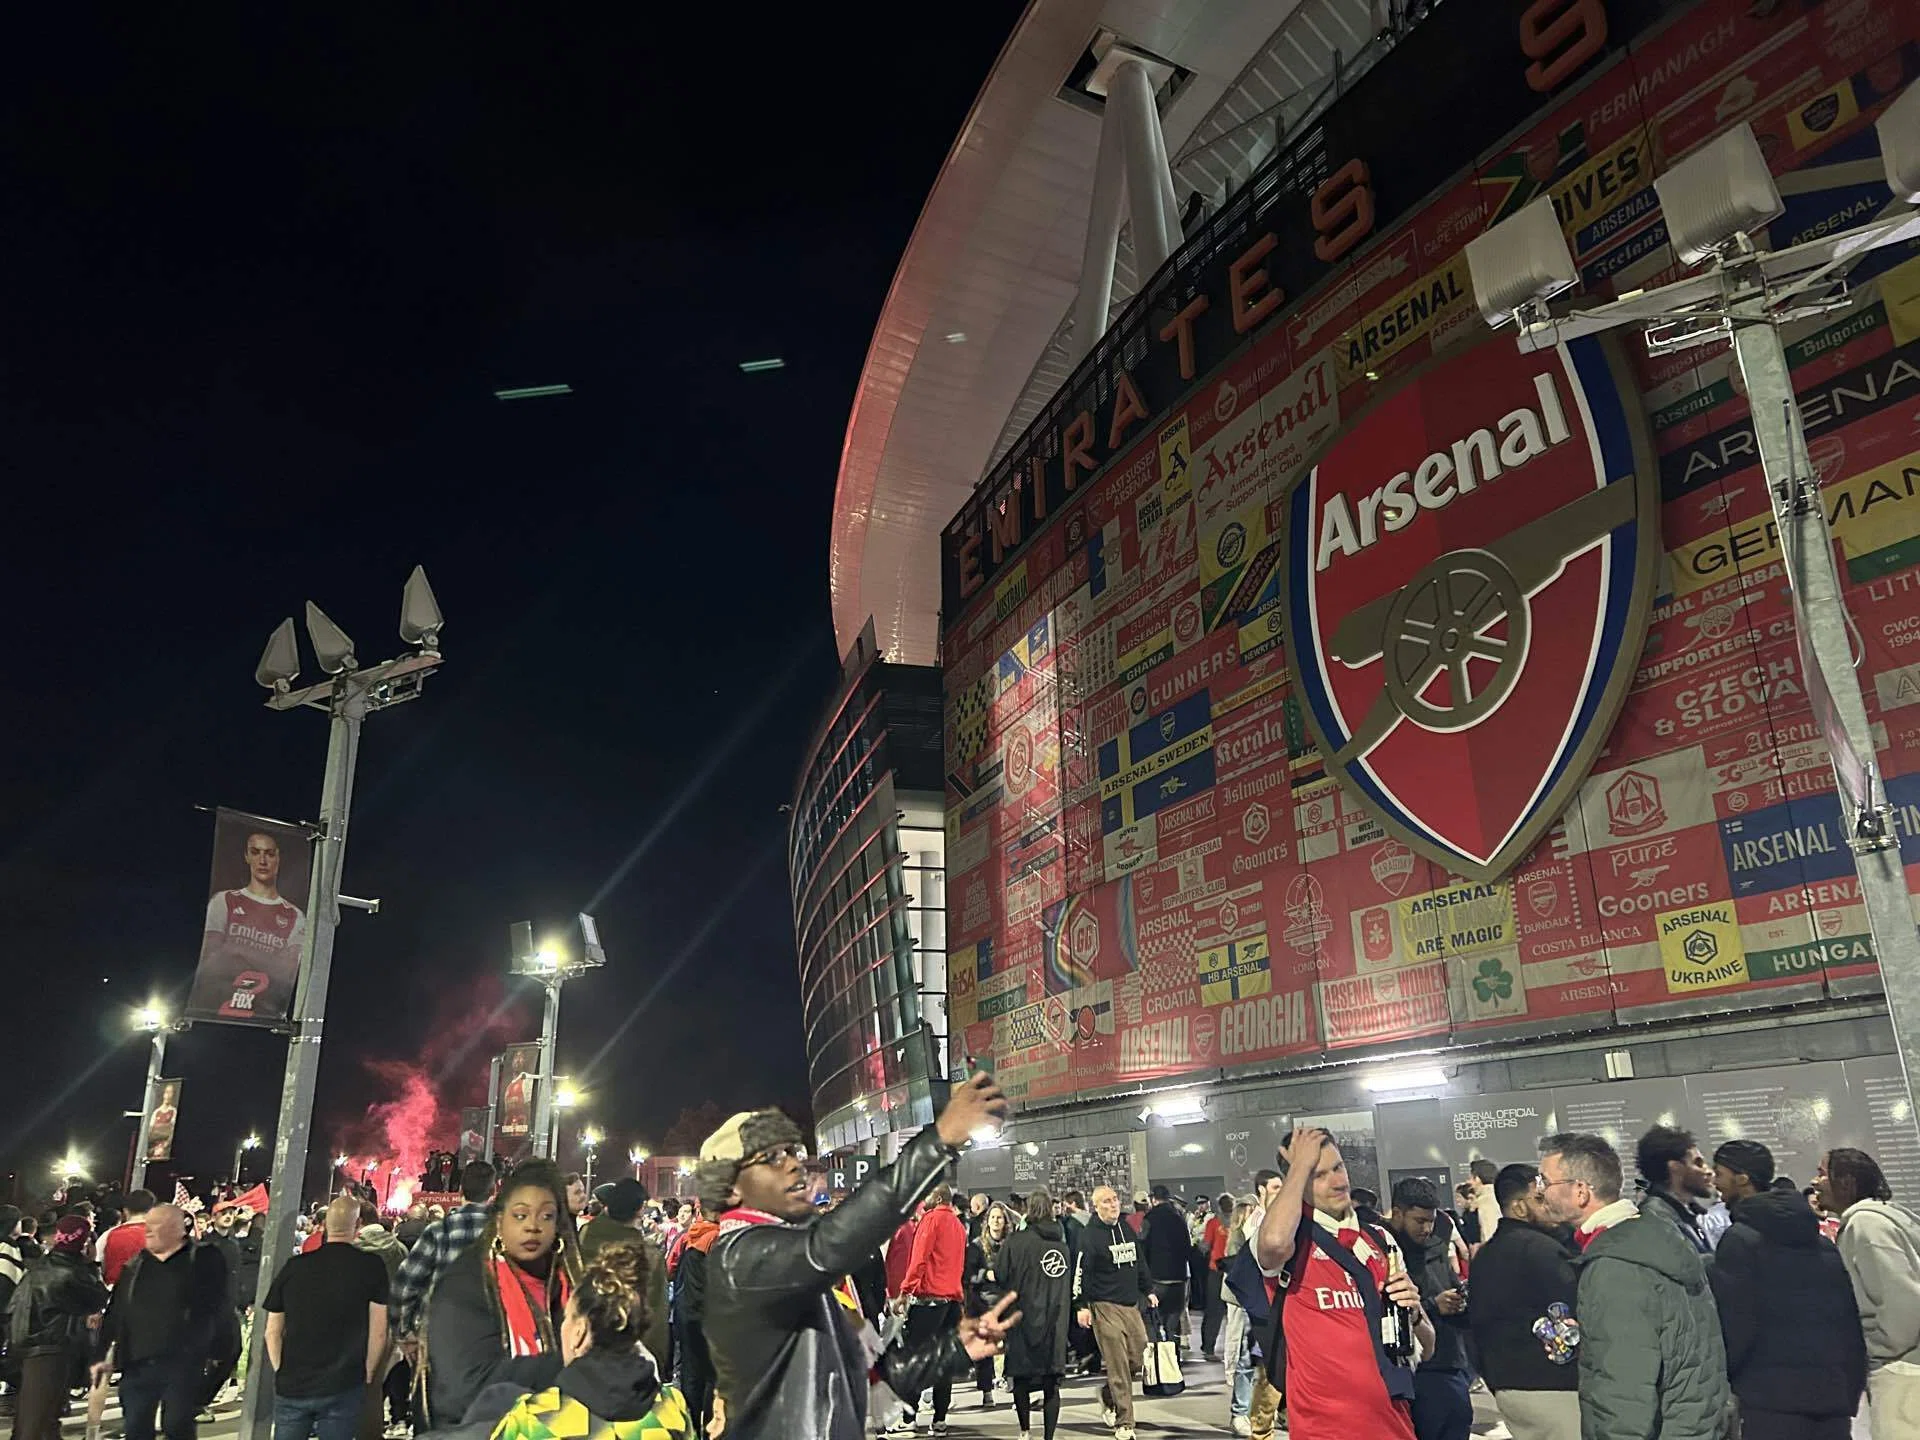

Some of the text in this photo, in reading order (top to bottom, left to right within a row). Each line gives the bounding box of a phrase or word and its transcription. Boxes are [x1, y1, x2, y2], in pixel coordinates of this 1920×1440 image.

[1588, 19, 1737, 134] FERMANAGH
[1592, 193, 1655, 242] ARSENAL
[1791, 196, 1879, 247] ARSENAL
[1424, 229, 1452, 256] CAPE
[1349, 271, 1465, 370] ARSENAL
[1797, 313, 1876, 357] Bulgaria
[958, 158, 1376, 598] EMIRATES
[1656, 390, 1715, 429] Arsenal
[1682, 359, 1920, 484] ARENA
[1161, 417, 1186, 443] ARSENAL
[1198, 361, 1332, 502] Arsenal
[1105, 448, 1157, 501] EAST SUSSEX
[1225, 472, 1277, 513] Supporters
[1280, 453, 1303, 473] Club
[1230, 443, 1295, 496] Armed Forces
[1315, 371, 1572, 573] Arsenal
[1120, 618, 1168, 653] ARSENAL
[1883, 616, 1920, 636] CWC
[1887, 630, 1920, 649] 1994
[1126, 653, 1165, 682] GHANA
[1244, 643, 1269, 664] NEWRY
[1637, 630, 1763, 682] SUPPORTERS
[1151, 643, 1237, 708] GUNNERS
[1674, 656, 1796, 710] CZECH
[1654, 678, 1801, 736] & SLOVA
[1103, 732, 1209, 795] ARSENAL SWEDEN
[1223, 769, 1286, 806] Islington
[1164, 798, 1211, 831] ARSENAL NYC
[1302, 809, 1369, 837] THE ARSEN
[1358, 820, 1375, 832] WEST
[1350, 828, 1385, 846] HAMPSTEAD
[1732, 823, 1836, 872] ARSENAL
[1232, 840, 1288, 875] Gooners
[1517, 865, 1563, 885] ARSENAL
[1009, 901, 1041, 924] VIETNAM
[1163, 887, 1204, 909] SUPPORTERS
[1411, 884, 1497, 915] ARSENAL
[1597, 881, 1709, 918] Gooners
[229, 922, 285, 949] Emirates
[1139, 908, 1194, 939] ARSENAL
[1524, 915, 1572, 934] DUNDALK
[1663, 909, 1731, 936] ARSENAL
[1416, 924, 1503, 956] ARE MAGIC
[1532, 924, 1643, 956] COSTA BLANCA
[980, 971, 1024, 996] ARSENAL
[1207, 960, 1262, 984] HB ARSENAL
[1324, 962, 1449, 1010] ARSENAL WOMEN
[1671, 958, 1744, 985] UKRAINE
[230, 992, 255, 1010] FOX
[983, 990, 1021, 1016] MEXICO
[1146, 987, 1197, 1015] CROATIA
[1559, 980, 1630, 1002] ARSENAL
[1219, 989, 1308, 1057] GEORGIA
[1329, 992, 1449, 1037] SUPPORTERS CLUB
[1119, 1015, 1193, 1073] ARSENAL
[1453, 1107, 1539, 1122] ARSENAL OFFICIAL
[1454, 1118, 1518, 1132] SUPPORTERS
[1455, 1129, 1487, 1141] CLUBS
[834, 1160, 869, 1188] R P
[1014, 1161, 1045, 1172] FOLLOW THE
